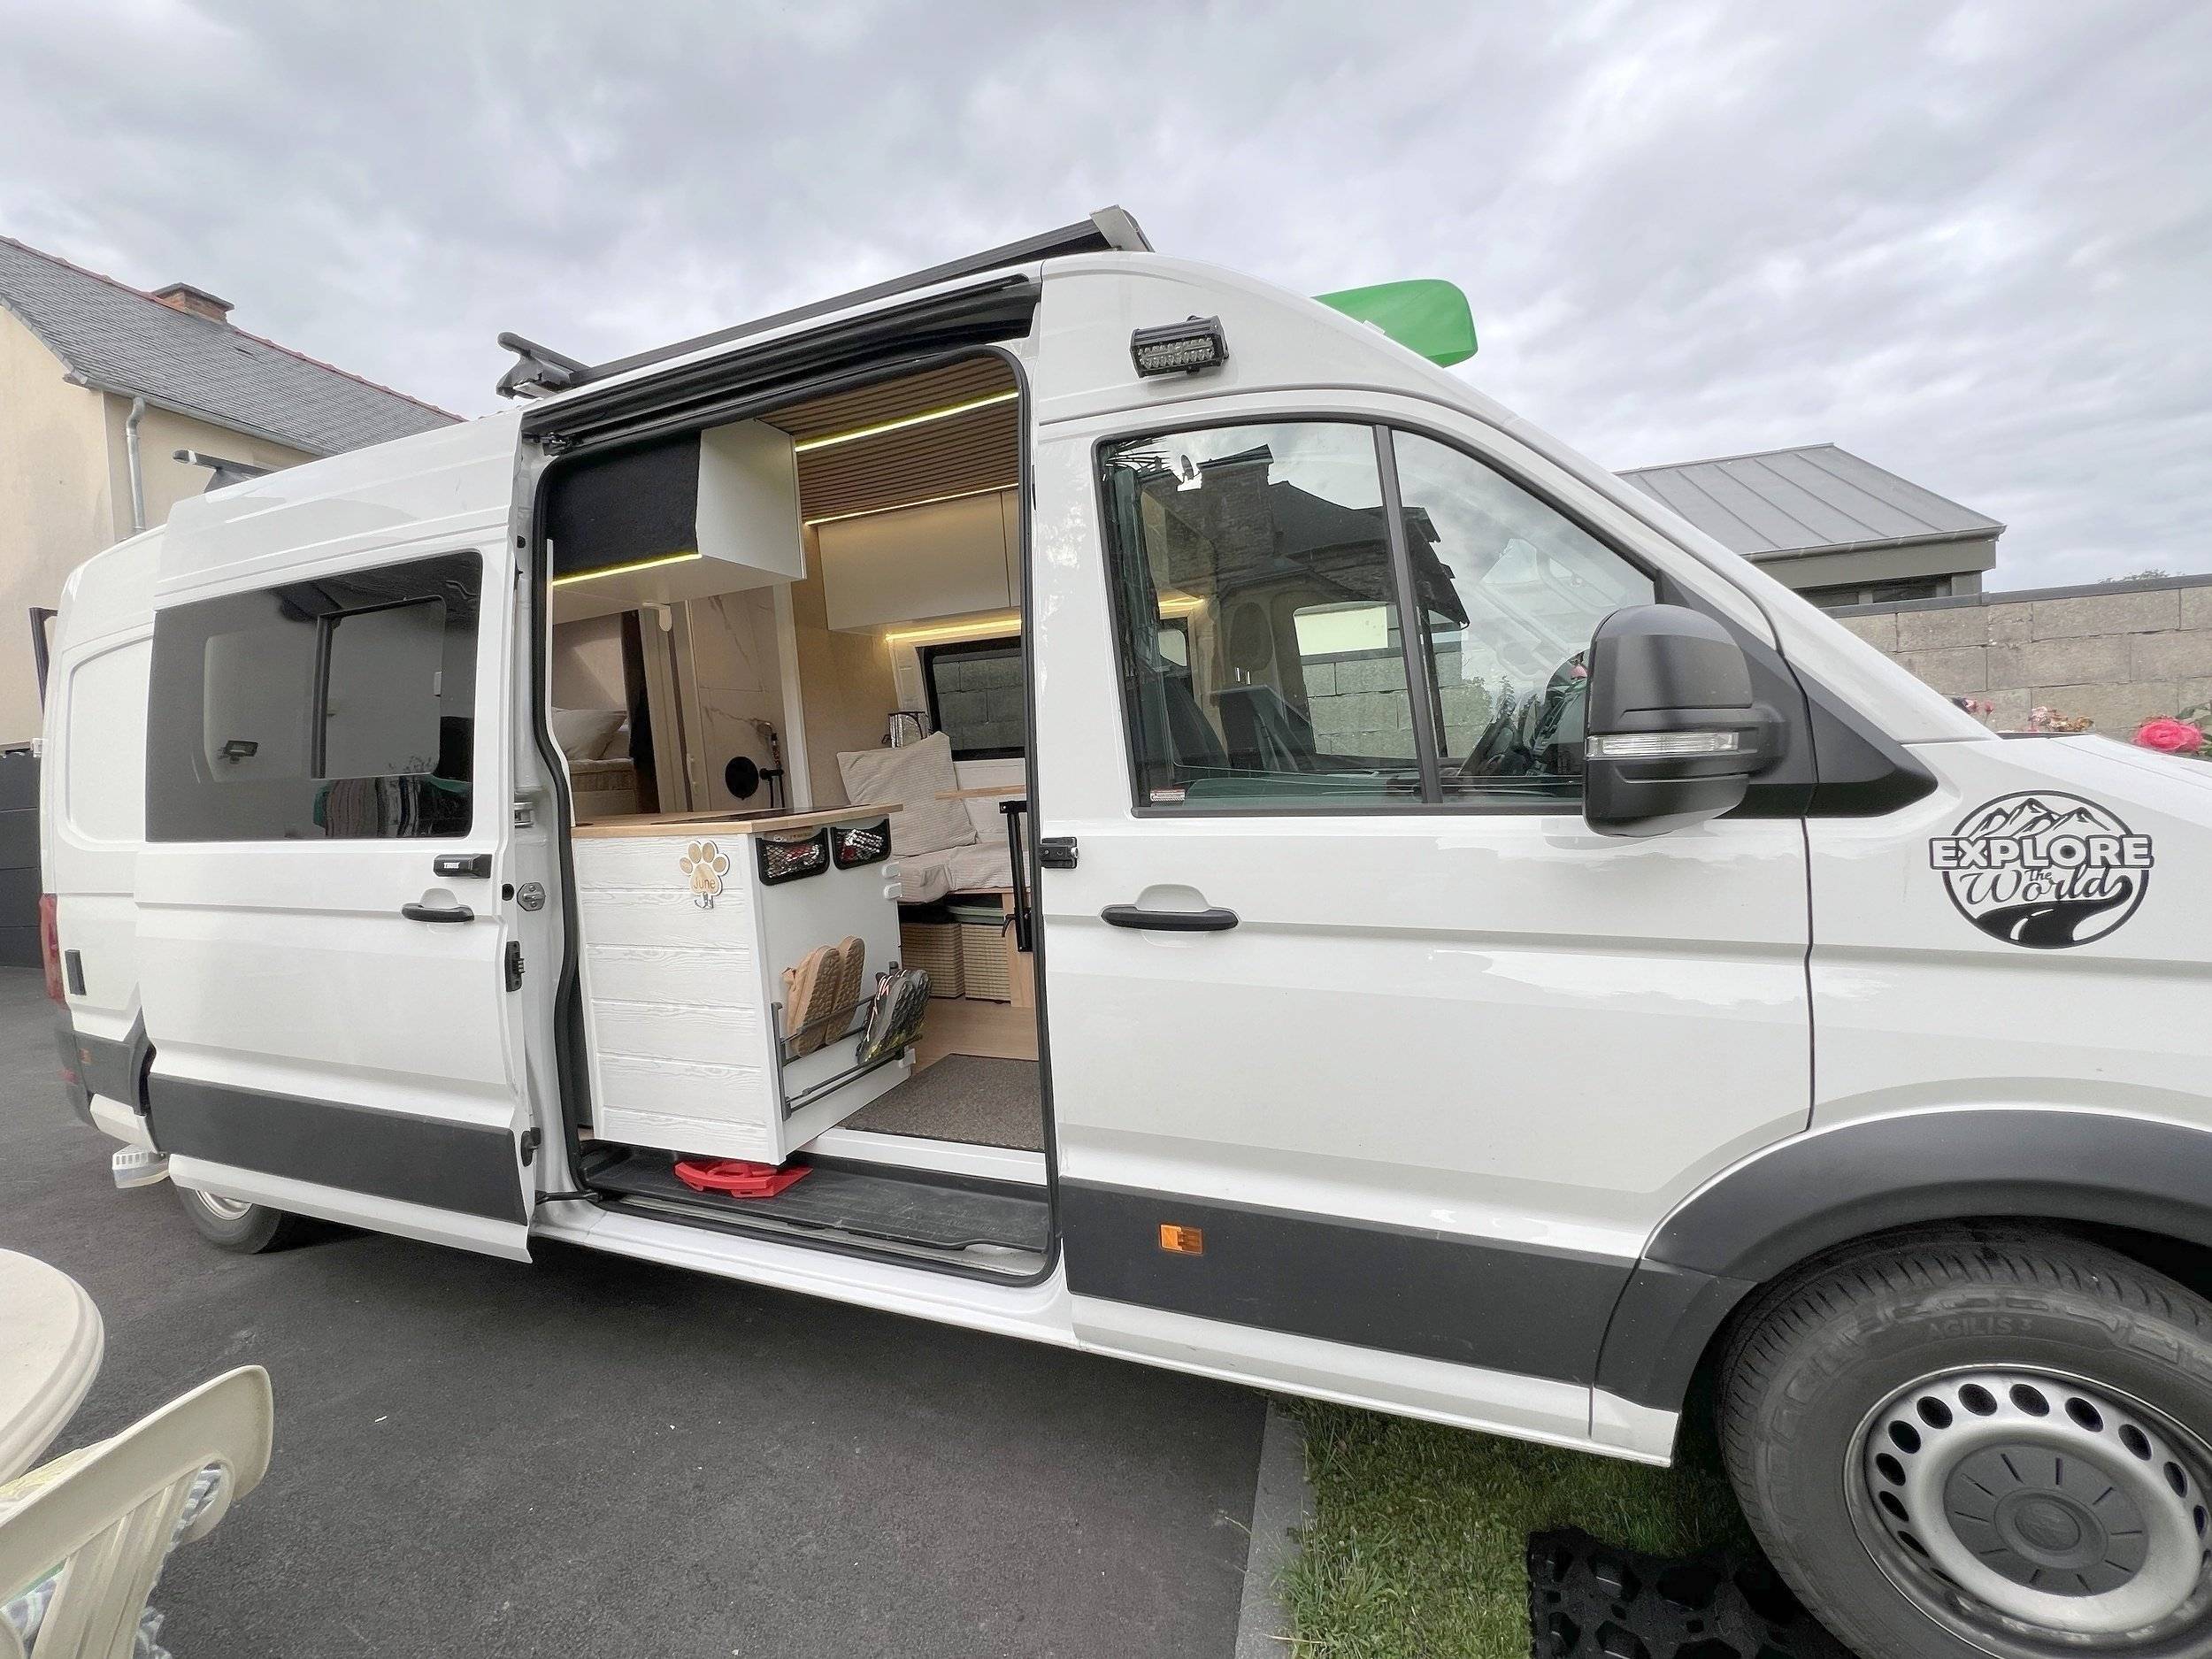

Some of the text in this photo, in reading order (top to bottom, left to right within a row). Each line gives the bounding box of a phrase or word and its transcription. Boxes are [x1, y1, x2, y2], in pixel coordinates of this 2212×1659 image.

[1930, 834, 2154, 870] EXPLORE
[693, 877, 716, 889] June
[1959, 865, 2118, 905] World
[2024, 869, 2053, 881] The
[1929, 1315, 2013, 1338] AGILIS
